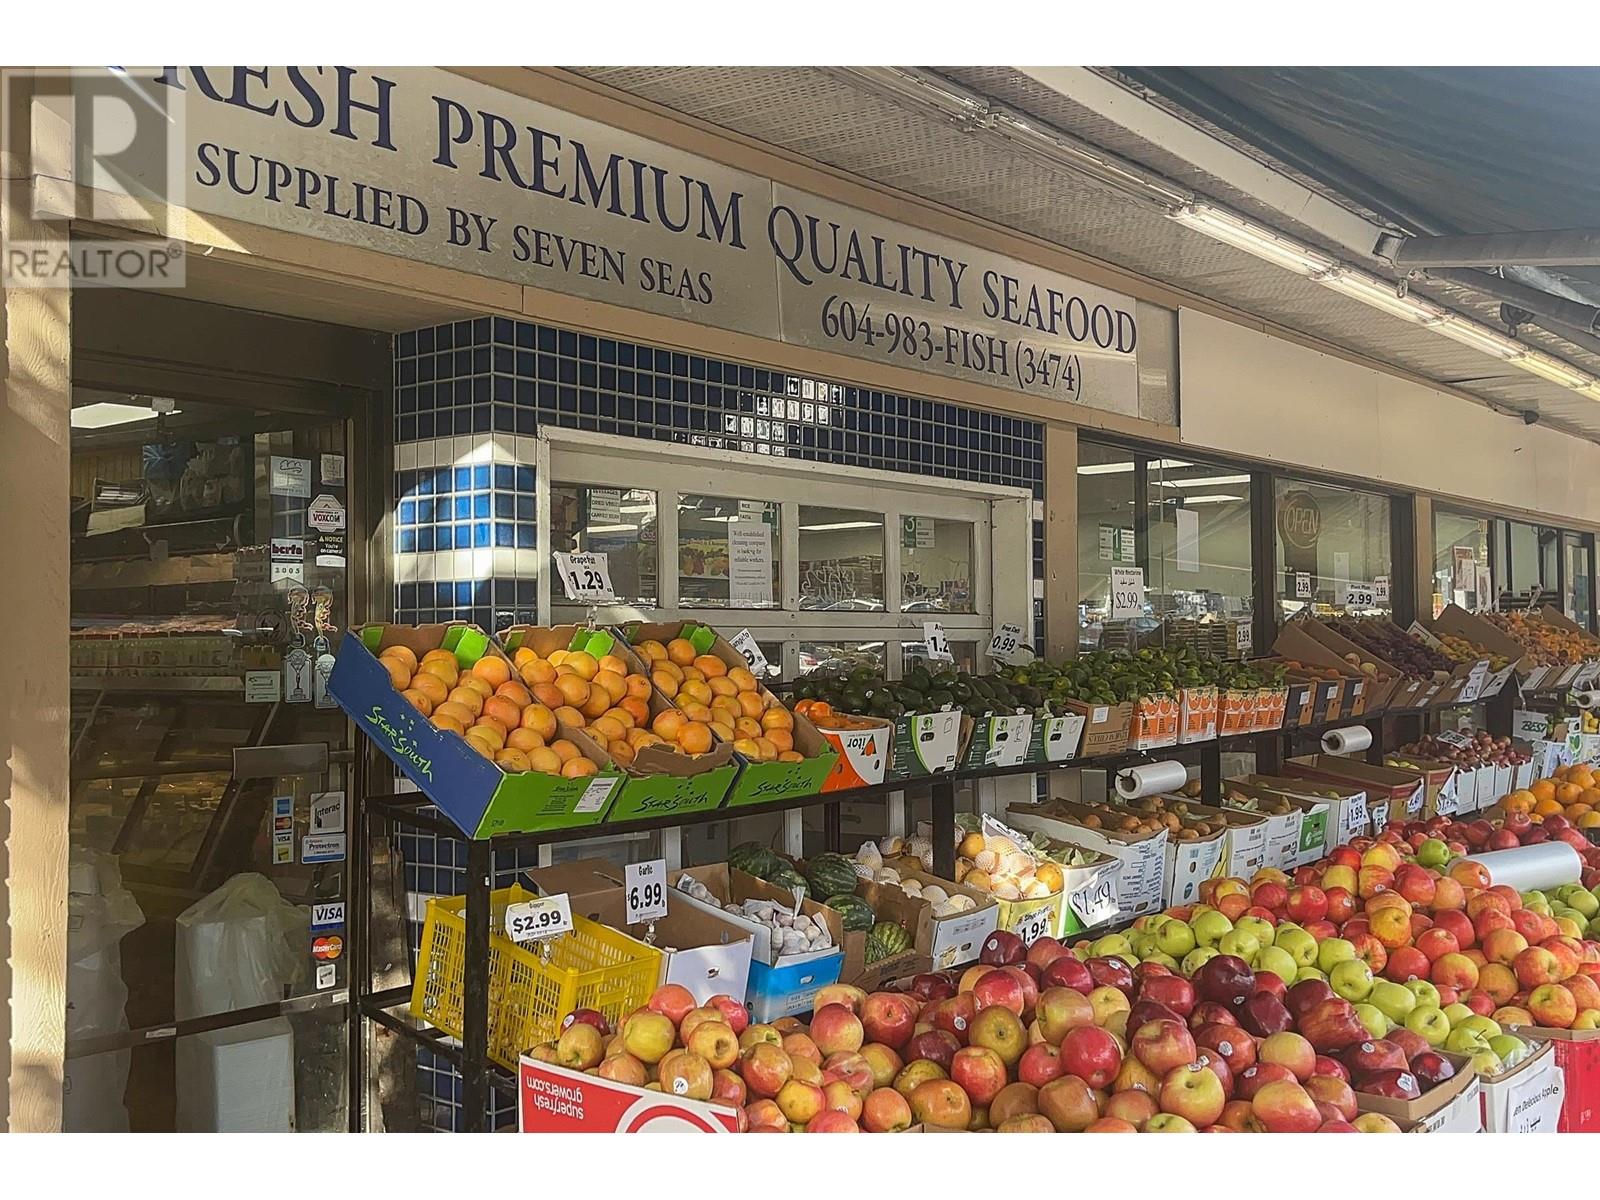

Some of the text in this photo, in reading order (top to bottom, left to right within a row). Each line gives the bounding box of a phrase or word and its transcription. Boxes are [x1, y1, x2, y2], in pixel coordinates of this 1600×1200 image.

[108, 66, 1138, 354] RESH PREMIUM QUALITY SEAFOOD
[196, 142, 713, 305] SUPPLIED BY SEVEN SEAS
[312, 512, 341, 523] VOXCOM
[1287, 506, 1320, 535] OPEN
[1116, 591, 1138, 609] $2.99
[314, 803, 341, 825] Interac
[638, 864, 653, 876] Garlic
[1073, 880, 1111, 916] $1.49
[316, 906, 343, 921] VISA
[513, 910, 561, 934] $2.99
[312, 943, 343, 954] MasterCard
[526, 1075, 583, 1104] growers.com
[533, 1093, 584, 1120] superfresh
